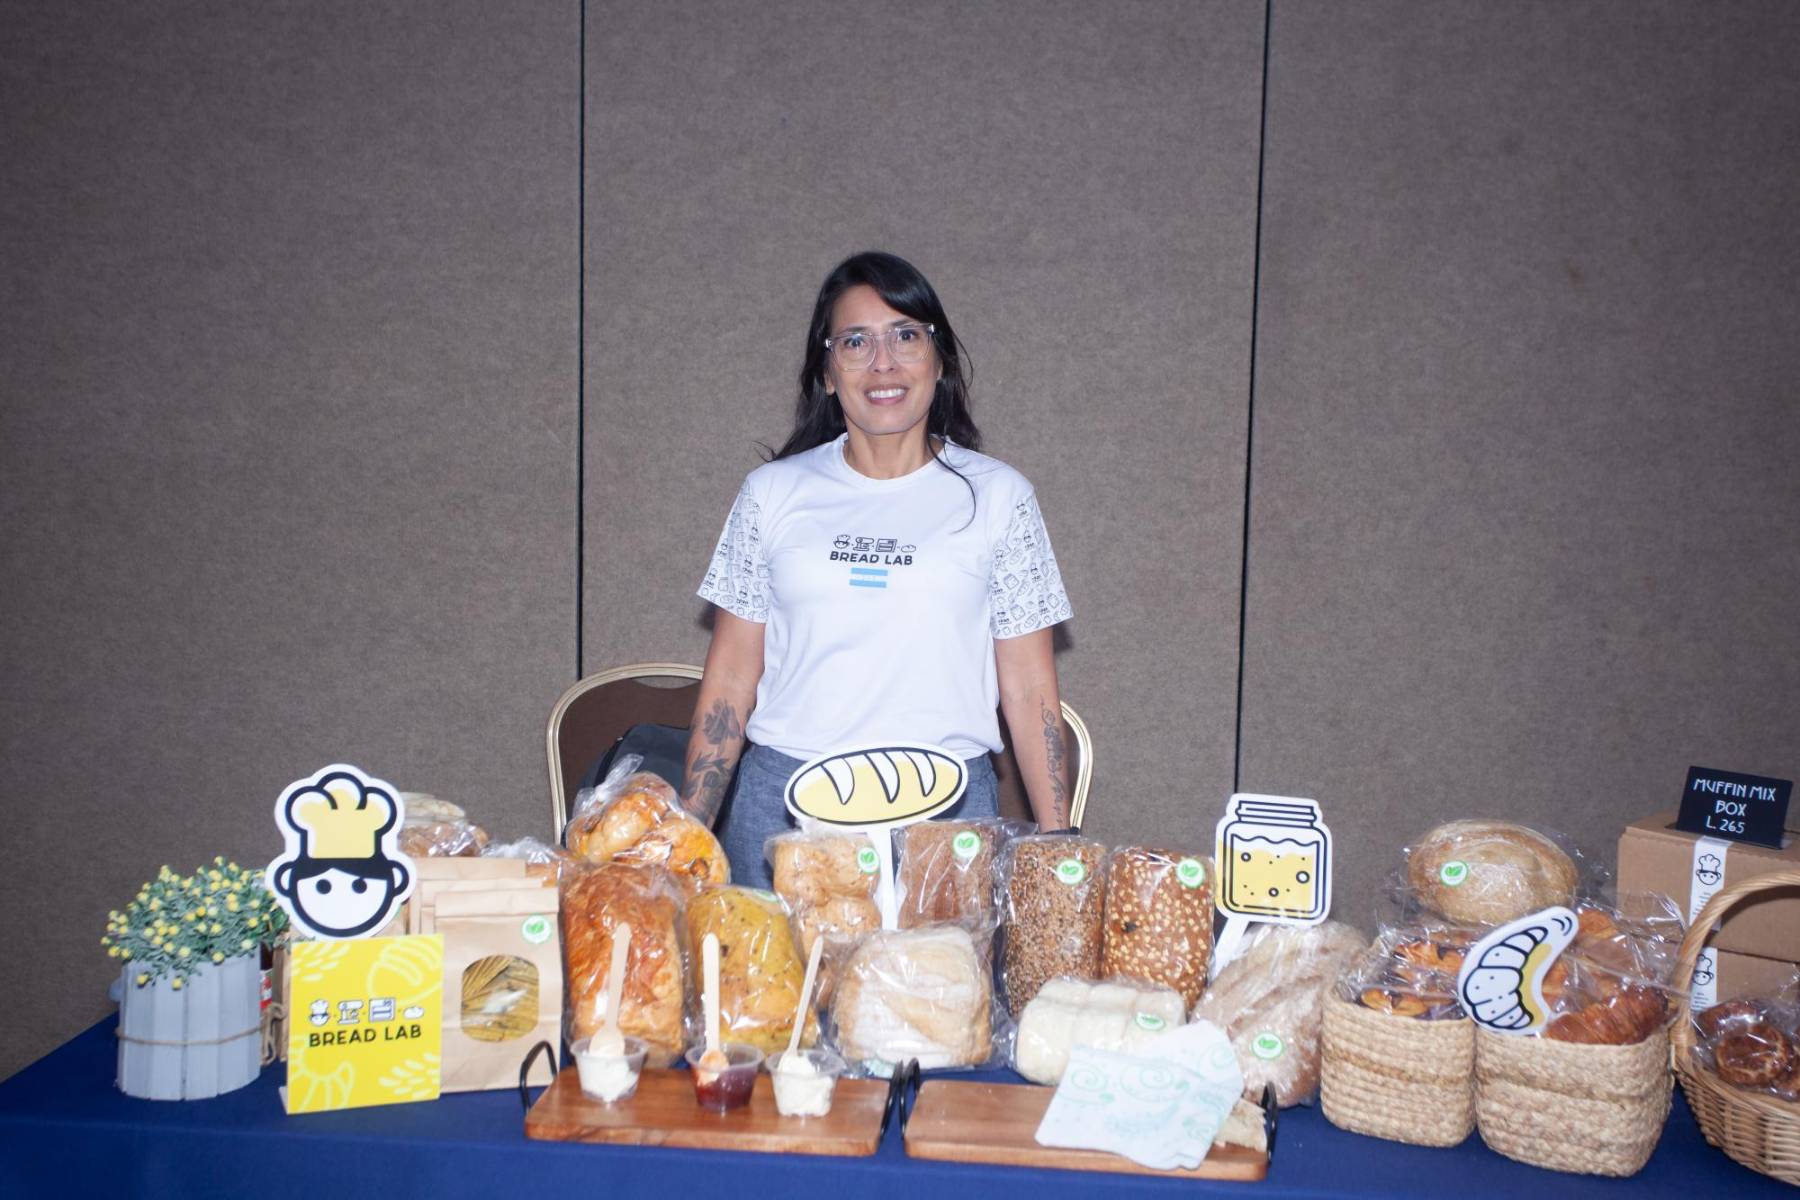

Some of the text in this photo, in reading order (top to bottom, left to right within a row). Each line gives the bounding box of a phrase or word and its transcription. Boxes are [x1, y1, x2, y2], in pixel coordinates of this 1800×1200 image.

[829, 551, 913, 566] BREAD LAB
[1693, 779, 1776, 802] MUFFIN MIX
[1716, 800, 1747, 817] BOX
[1719, 819, 1746, 834] 265
[309, 1024, 422, 1047] BREAD LAB
